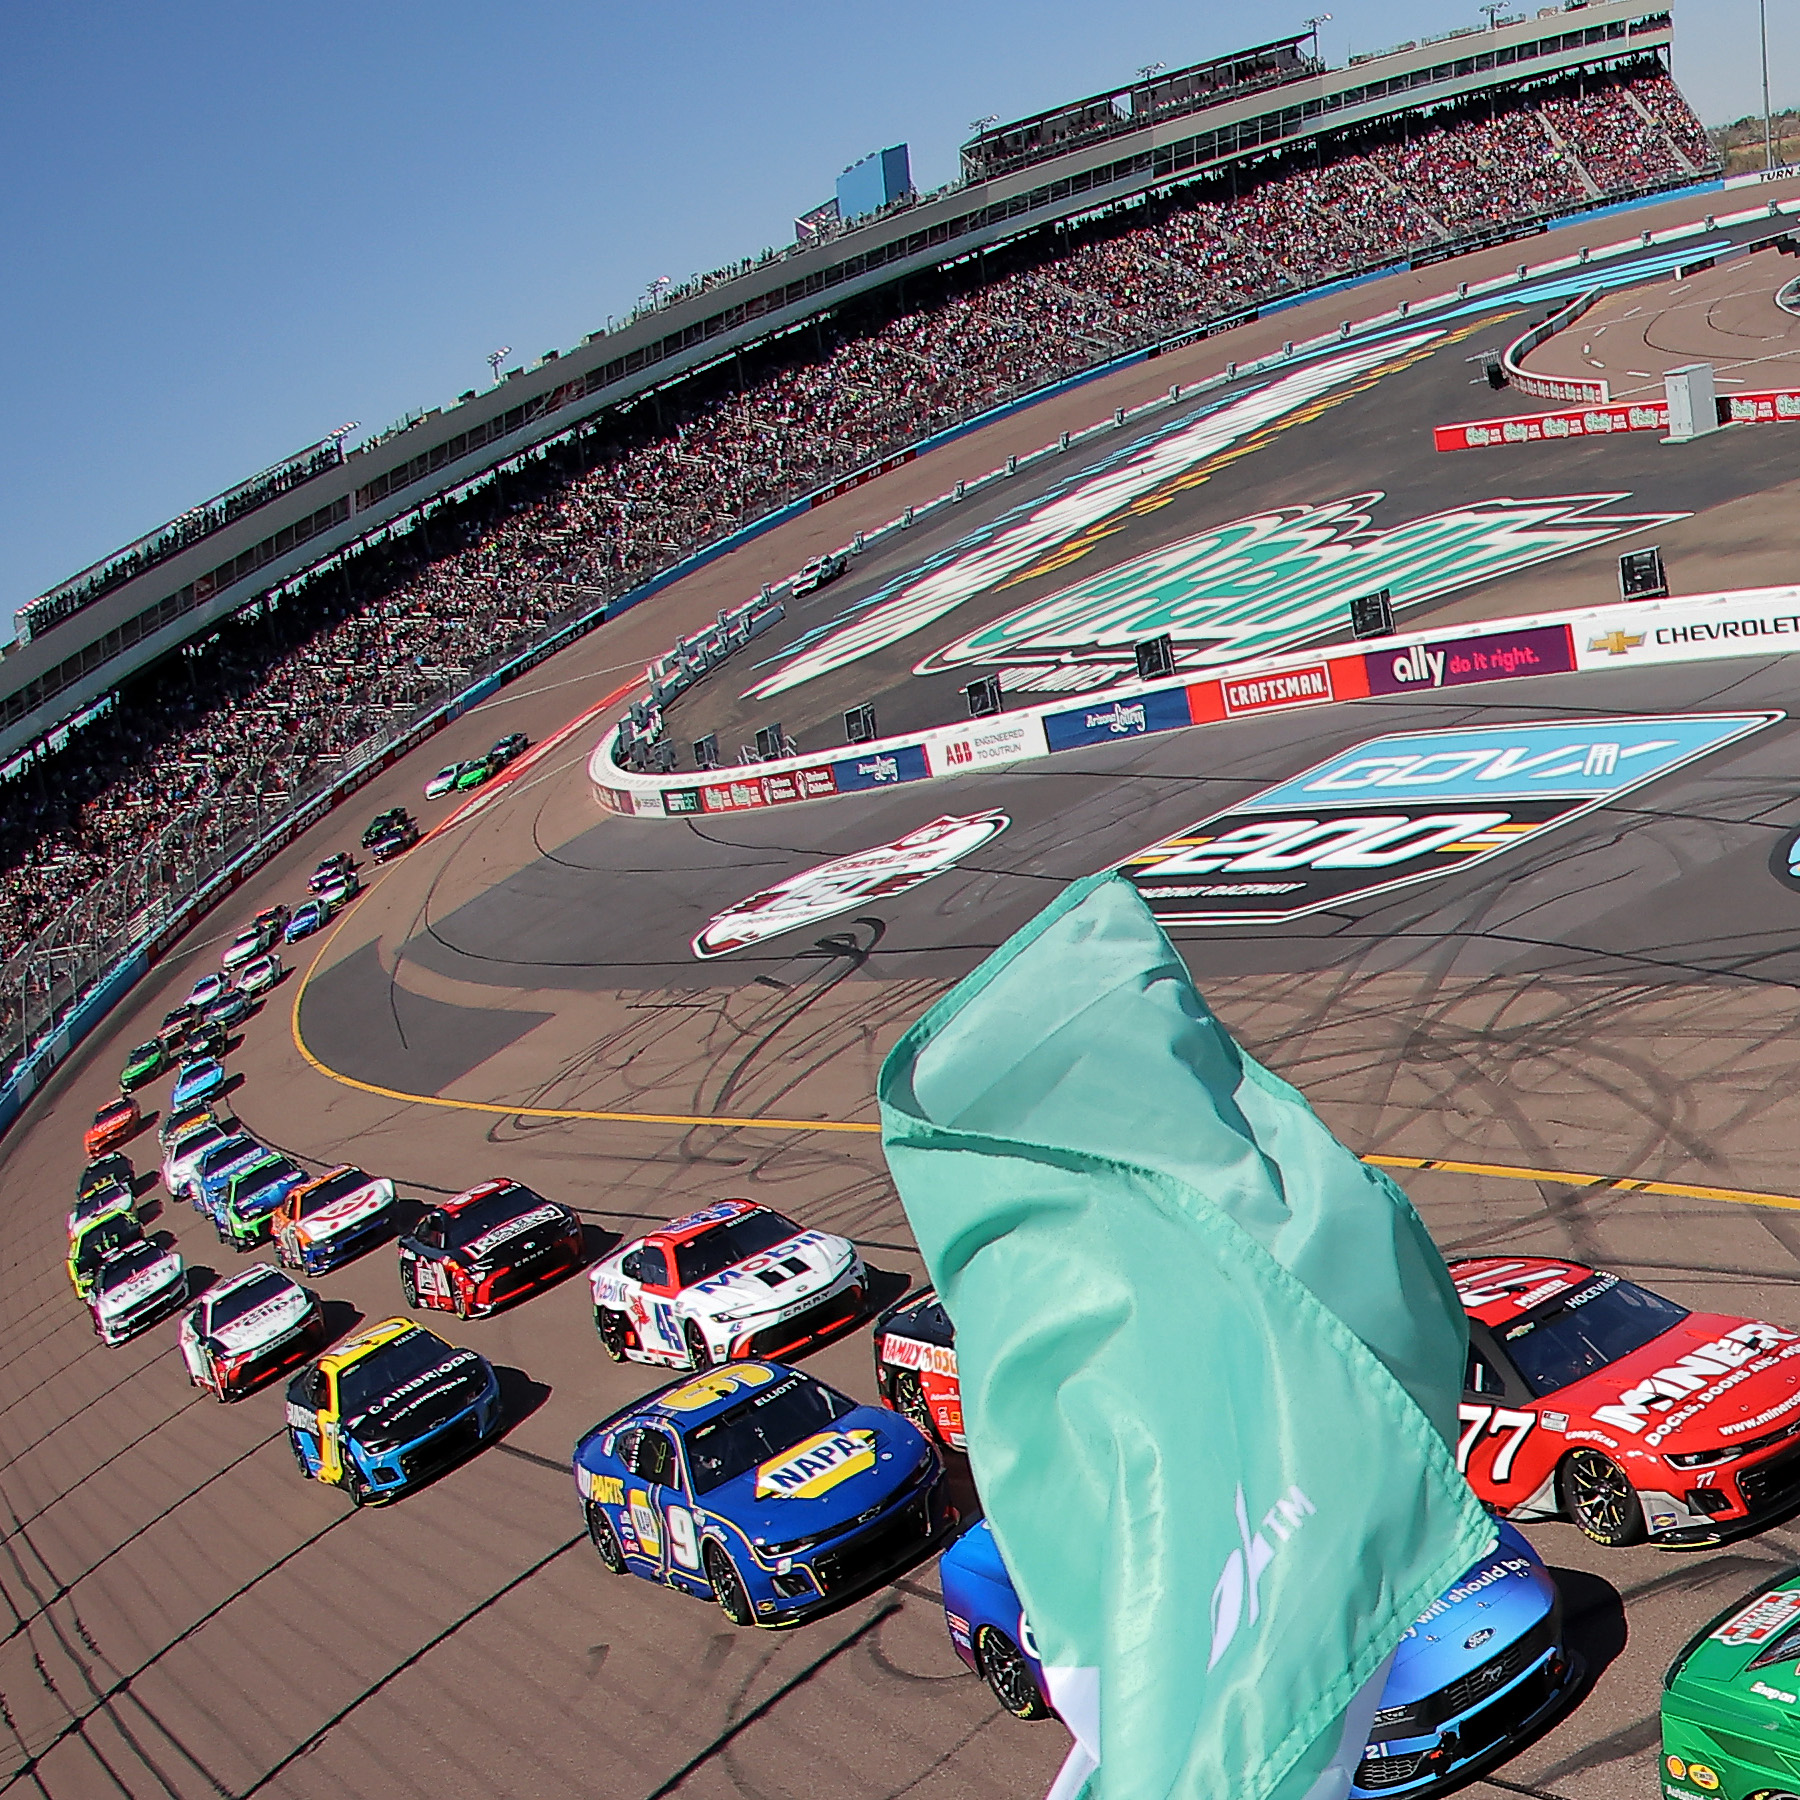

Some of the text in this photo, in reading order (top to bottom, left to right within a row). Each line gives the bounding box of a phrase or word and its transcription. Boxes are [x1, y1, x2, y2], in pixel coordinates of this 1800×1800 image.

[1760, 167, 1793, 183] TURN
[1656, 616, 1800, 645] CHEVROLET
[1392, 645, 1540, 687] ally do it right.
[1230, 674, 1322, 705] CRAFTSMAN
[974, 728, 1025, 747] ENGINEERED
[977, 743, 1021, 760] TO OUTRUN
[945, 741, 972, 767] ABB
[1303, 738, 1681, 792] GOVX
[1134, 813, 1510, 877] 200
[695, 1231, 827, 1295] Mobil
[783, 1289, 833, 1318] CAMRY
[1512, 1279, 1568, 1307] MINER
[1564, 1276, 1620, 1310] HOCEVAR
[393, 1326, 424, 1348] HALEY
[654, 1302, 687, 1351] 45
[884, 1336, 921, 1367] FAMILY
[367, 1351, 478, 1415] GAINBRIDGE
[755, 1377, 800, 1408] ELLIOTT
[1590, 1323, 1800, 1435] MINER
[1644, 1403, 1706, 1448] DOCKS,
[1696, 1369, 1752, 1404] DOORS
[1457, 1402, 1538, 1480] 77
[769, 1435, 858, 1491] NAPA
[1696, 1470, 1717, 1487] 77
[665, 1504, 699, 1571] 9
[1415, 1557, 1531, 1627] wifi should be
[1365, 1742, 1389, 1760] 21
